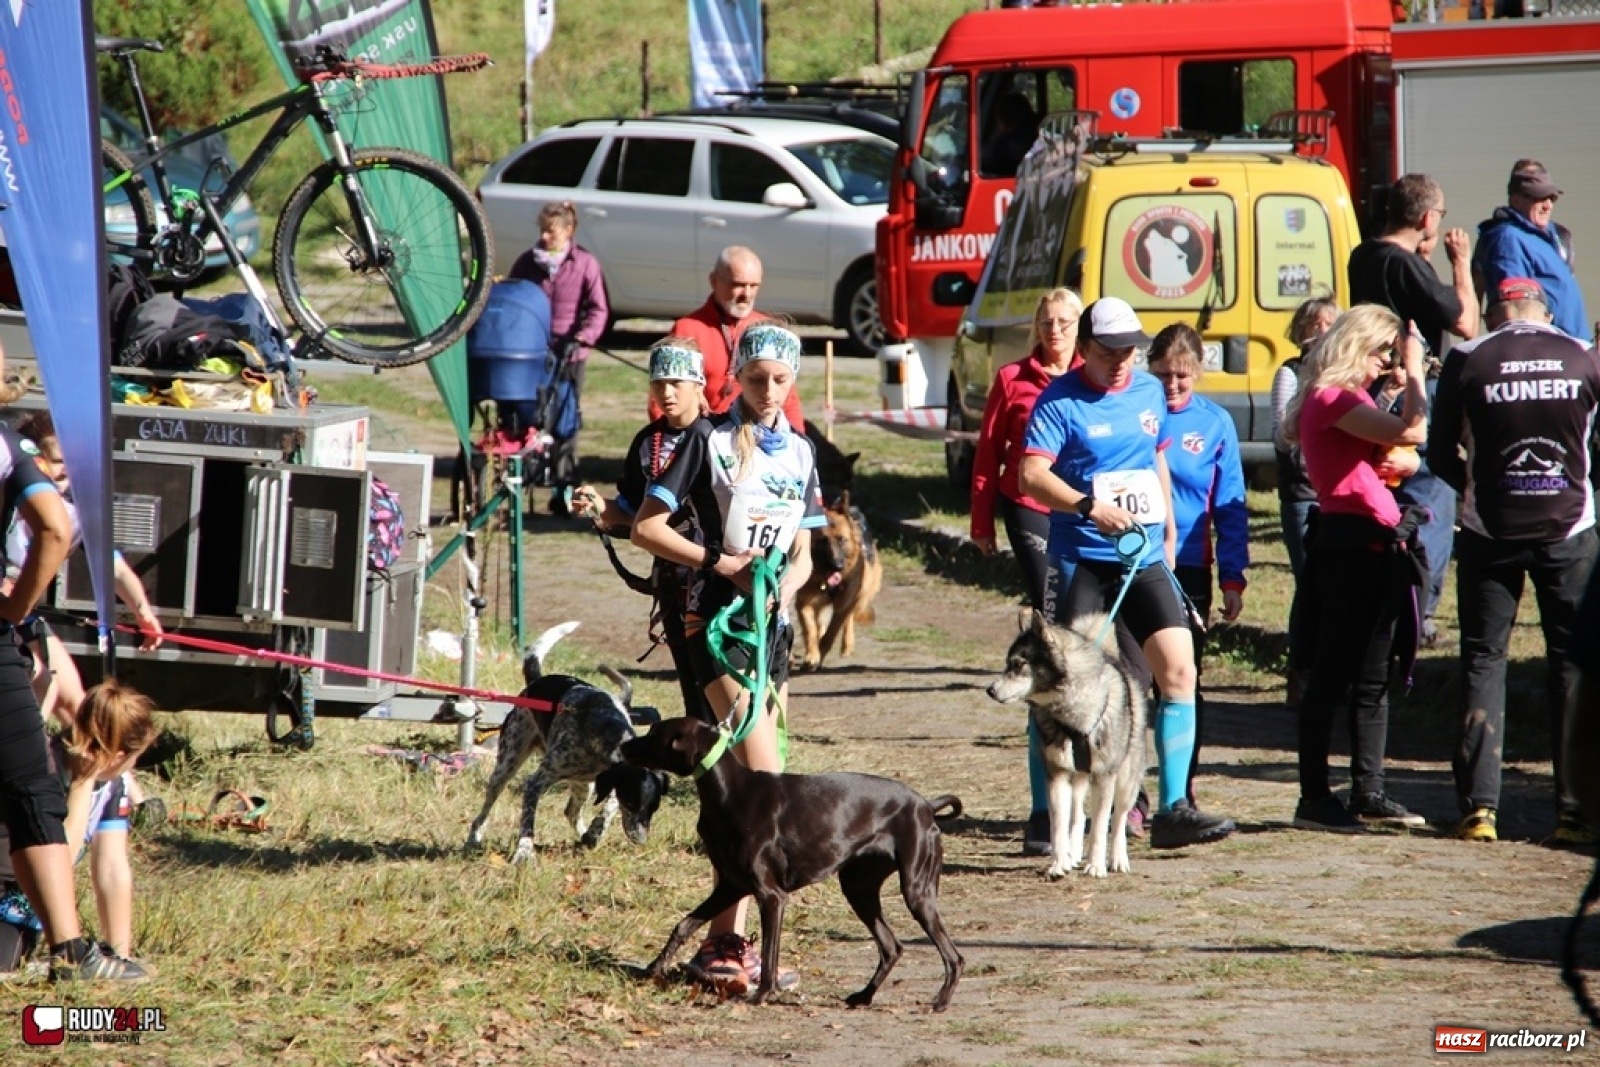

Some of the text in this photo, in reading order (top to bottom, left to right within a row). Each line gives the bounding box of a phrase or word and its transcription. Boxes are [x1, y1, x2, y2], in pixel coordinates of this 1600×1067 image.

[1501, 359, 1564, 374] ZBYSZEK
[1485, 378, 1582, 403] KUNERT
[139, 419, 187, 440] GAJA
[1113, 493, 1150, 514] 103
[747, 523, 781, 548] 161
